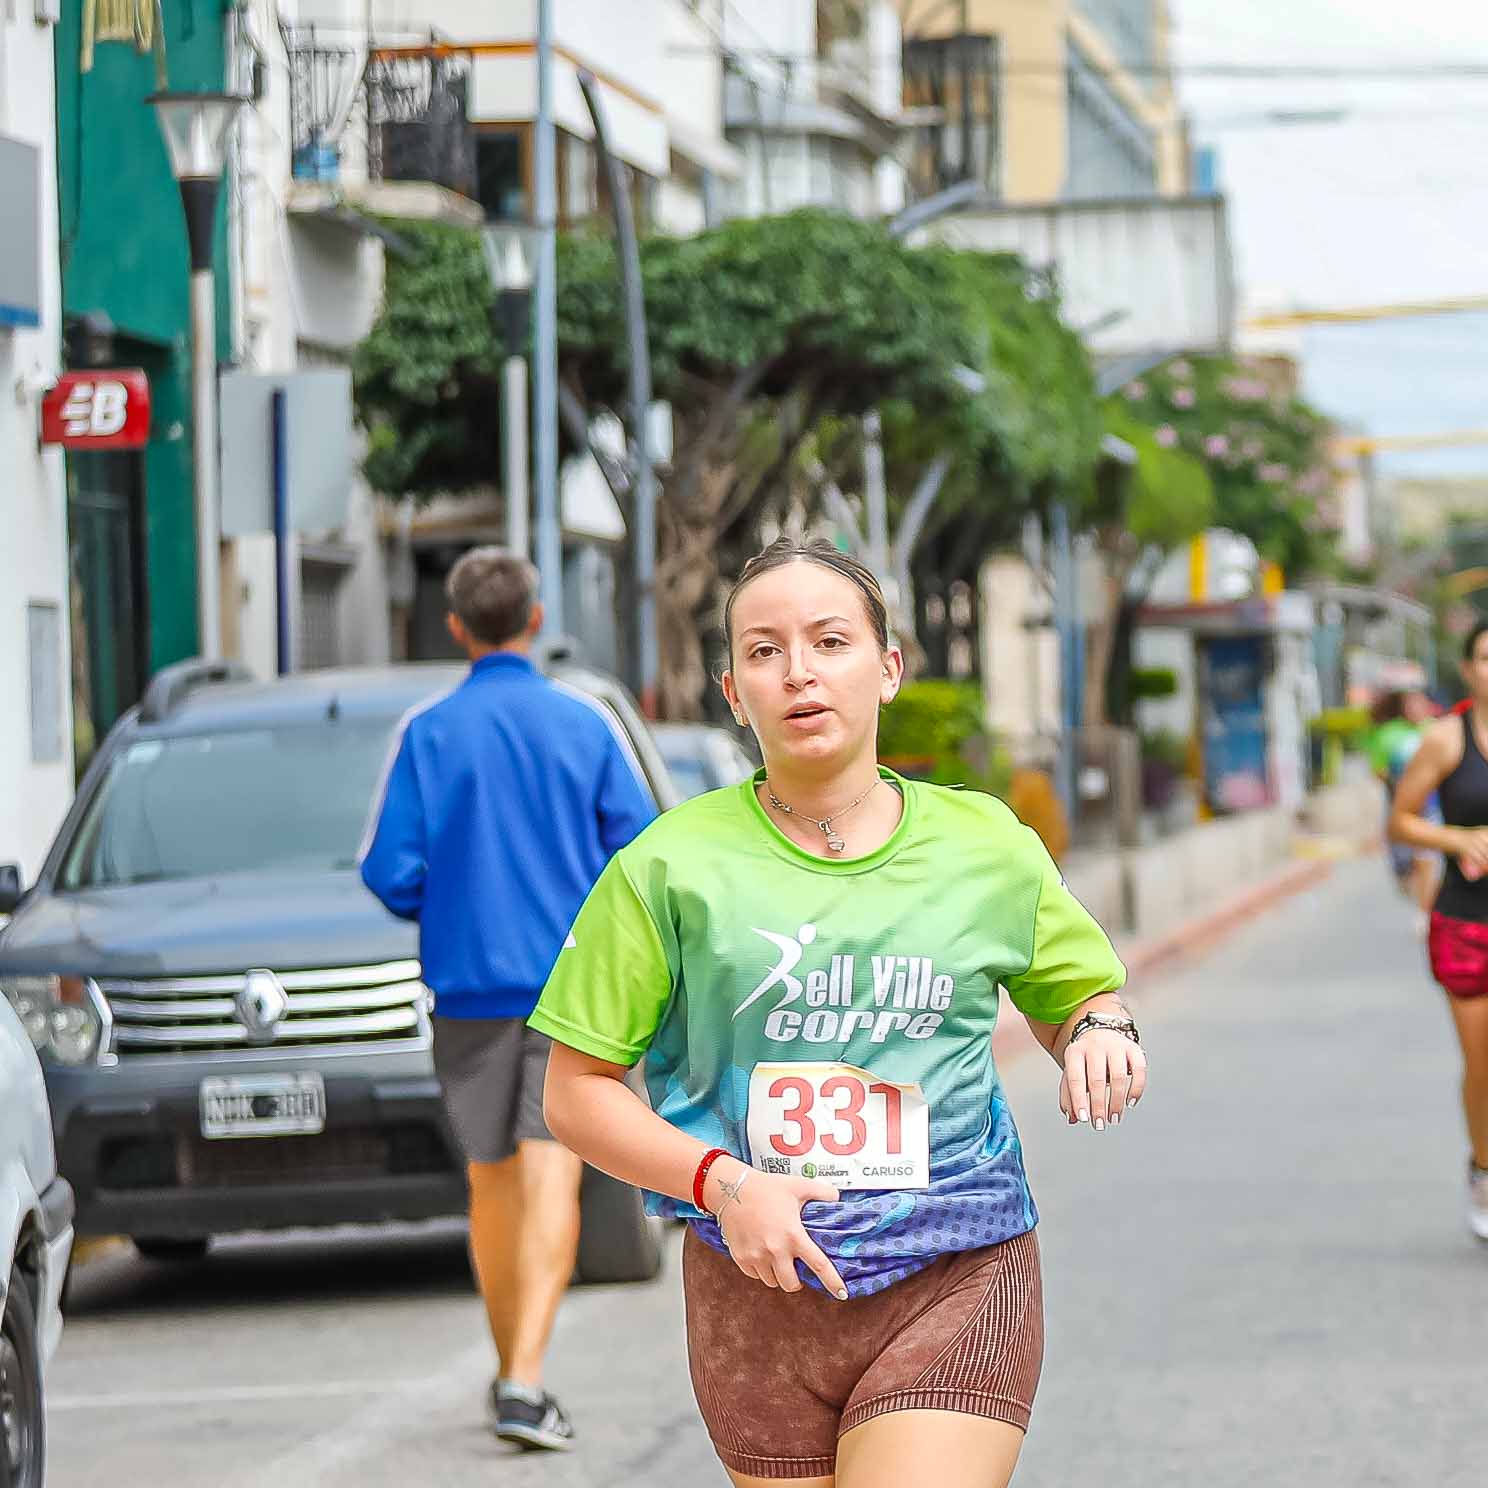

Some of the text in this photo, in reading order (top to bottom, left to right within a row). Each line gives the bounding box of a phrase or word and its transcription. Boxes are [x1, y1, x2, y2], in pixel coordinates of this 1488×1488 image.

[871, 956, 954, 1011] Ville
[764, 1009, 945, 1043] corre
[769, 1076, 902, 1157] 331
[863, 1166, 914, 1177] CARUSO
